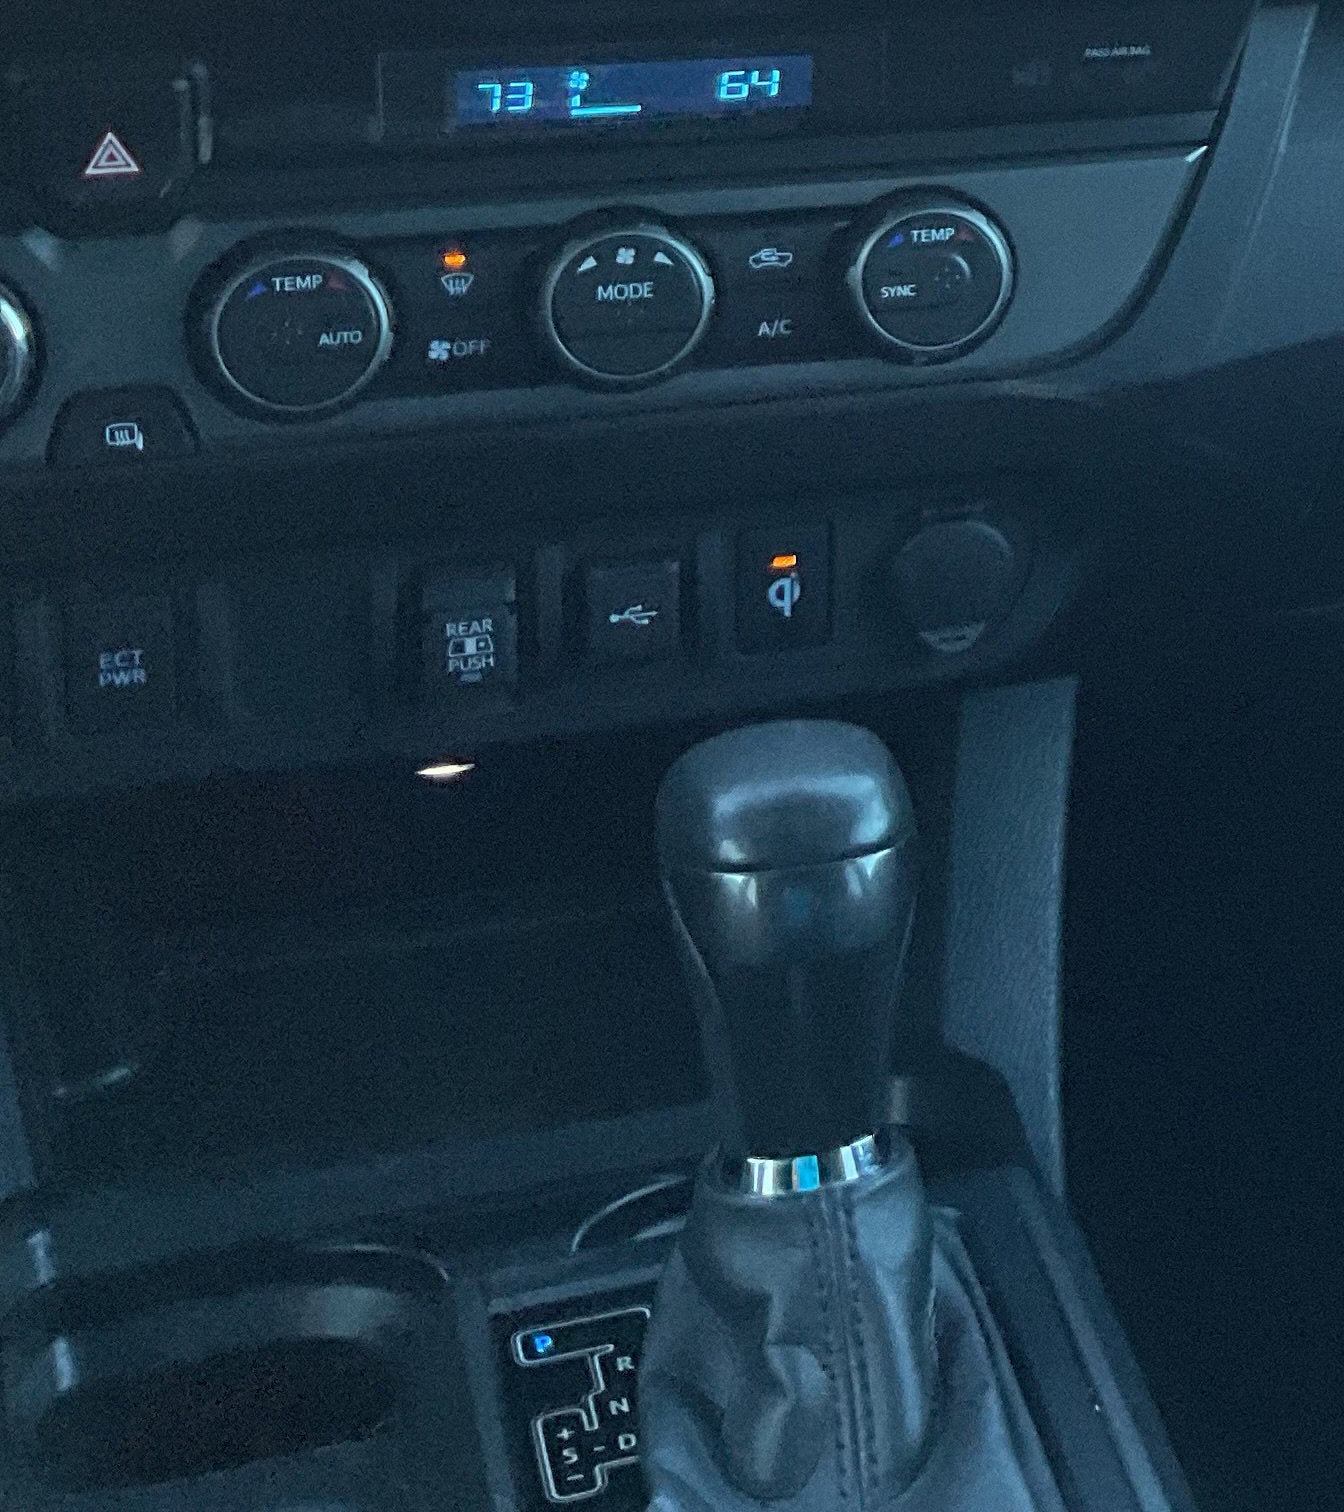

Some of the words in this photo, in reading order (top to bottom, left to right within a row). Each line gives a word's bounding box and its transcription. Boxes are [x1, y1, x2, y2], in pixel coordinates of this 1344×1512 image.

[477, 81, 534, 111] 73
[720, 69, 781, 101] 64
[910, 227, 956, 244] TEMP
[271, 274, 323, 292] TEMP
[597, 282, 655, 301] MODE
[881, 284, 917, 298] SYNC
[758, 319, 793, 337] A/C
[318, 330, 363, 347] AUTO
[452, 339, 491, 358] OFF
[446, 618, 494, 637] REAR
[100, 649, 144, 669] ECT
[448, 655, 495, 673] PUSH
[99, 668, 147, 687] PWR
[535, 1335, 553, 1353] P
[617, 1356, 635, 1371] R
[610, 1397, 630, 1415] N
[563, 1447, 579, 1465] S
[619, 1433, 637, 1450] D
